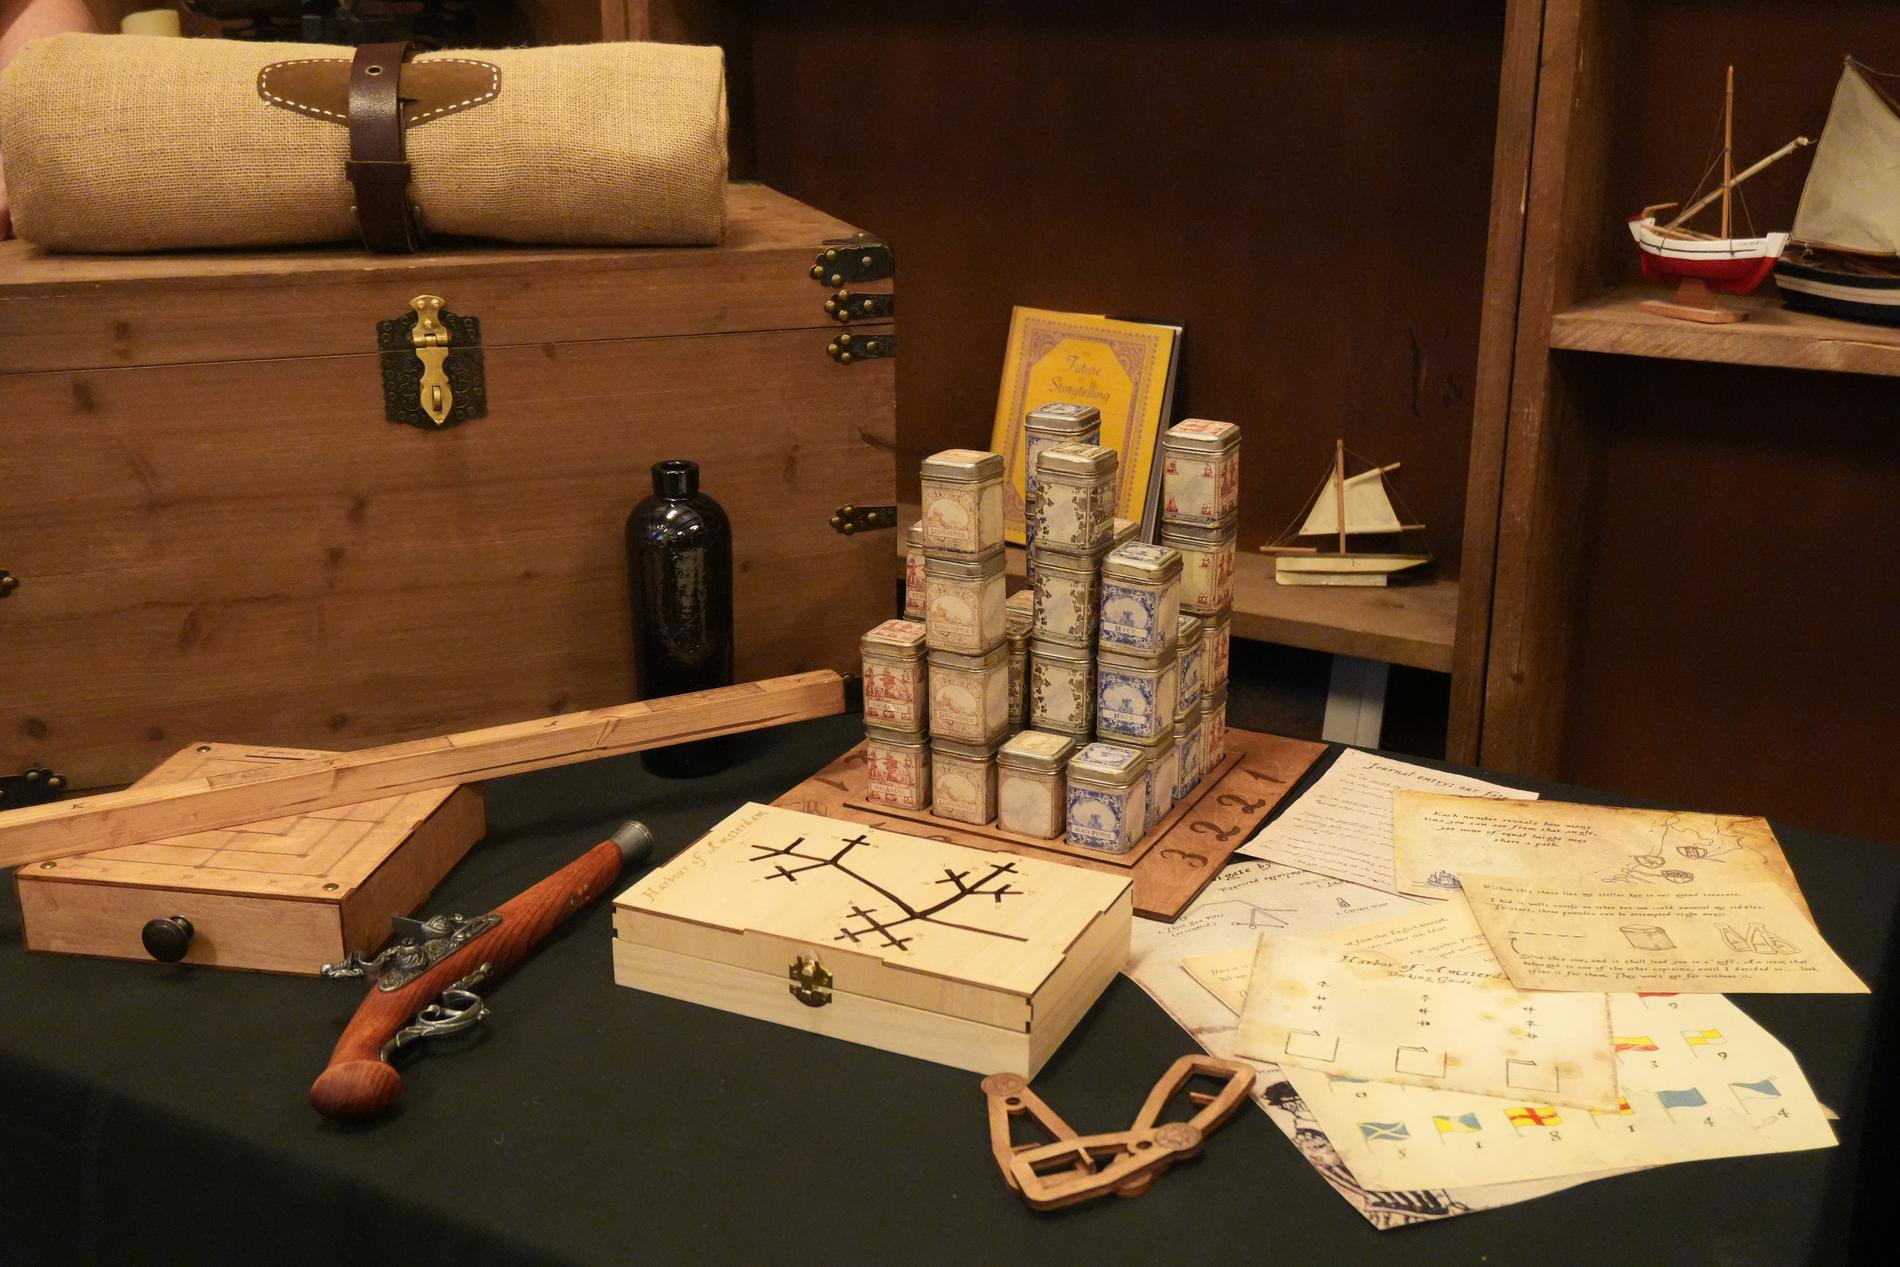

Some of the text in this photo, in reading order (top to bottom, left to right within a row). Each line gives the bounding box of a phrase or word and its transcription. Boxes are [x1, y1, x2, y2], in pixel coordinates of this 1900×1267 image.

[1064, 355, 1101, 376] Future
[1048, 376, 1111, 404] Storytelling
[1363, 760, 1416, 778] Journal
[1416, 774, 1454, 788] entry:
[1458, 785, 1481, 794] our
[1463, 814, 1497, 822] number
[1503, 818, 1539, 826] reveals
[1544, 820, 1561, 828] how
[1507, 823, 1537, 831] from
[691, 850, 706, 868] of
[708, 810, 769, 855] Amsterdam
[1160, 848, 1208, 868] 3
[1189, 821, 1241, 842] 2
[1216, 794, 1266, 815] 2
[1533, 834, 1562, 842] height
[1494, 837, 1520, 845] share
[1225, 867, 1252, 881] gate
[1257, 863, 1272, 871] by
[1218, 877, 1259, 892] Required
[1401, 963, 1425, 973] of
